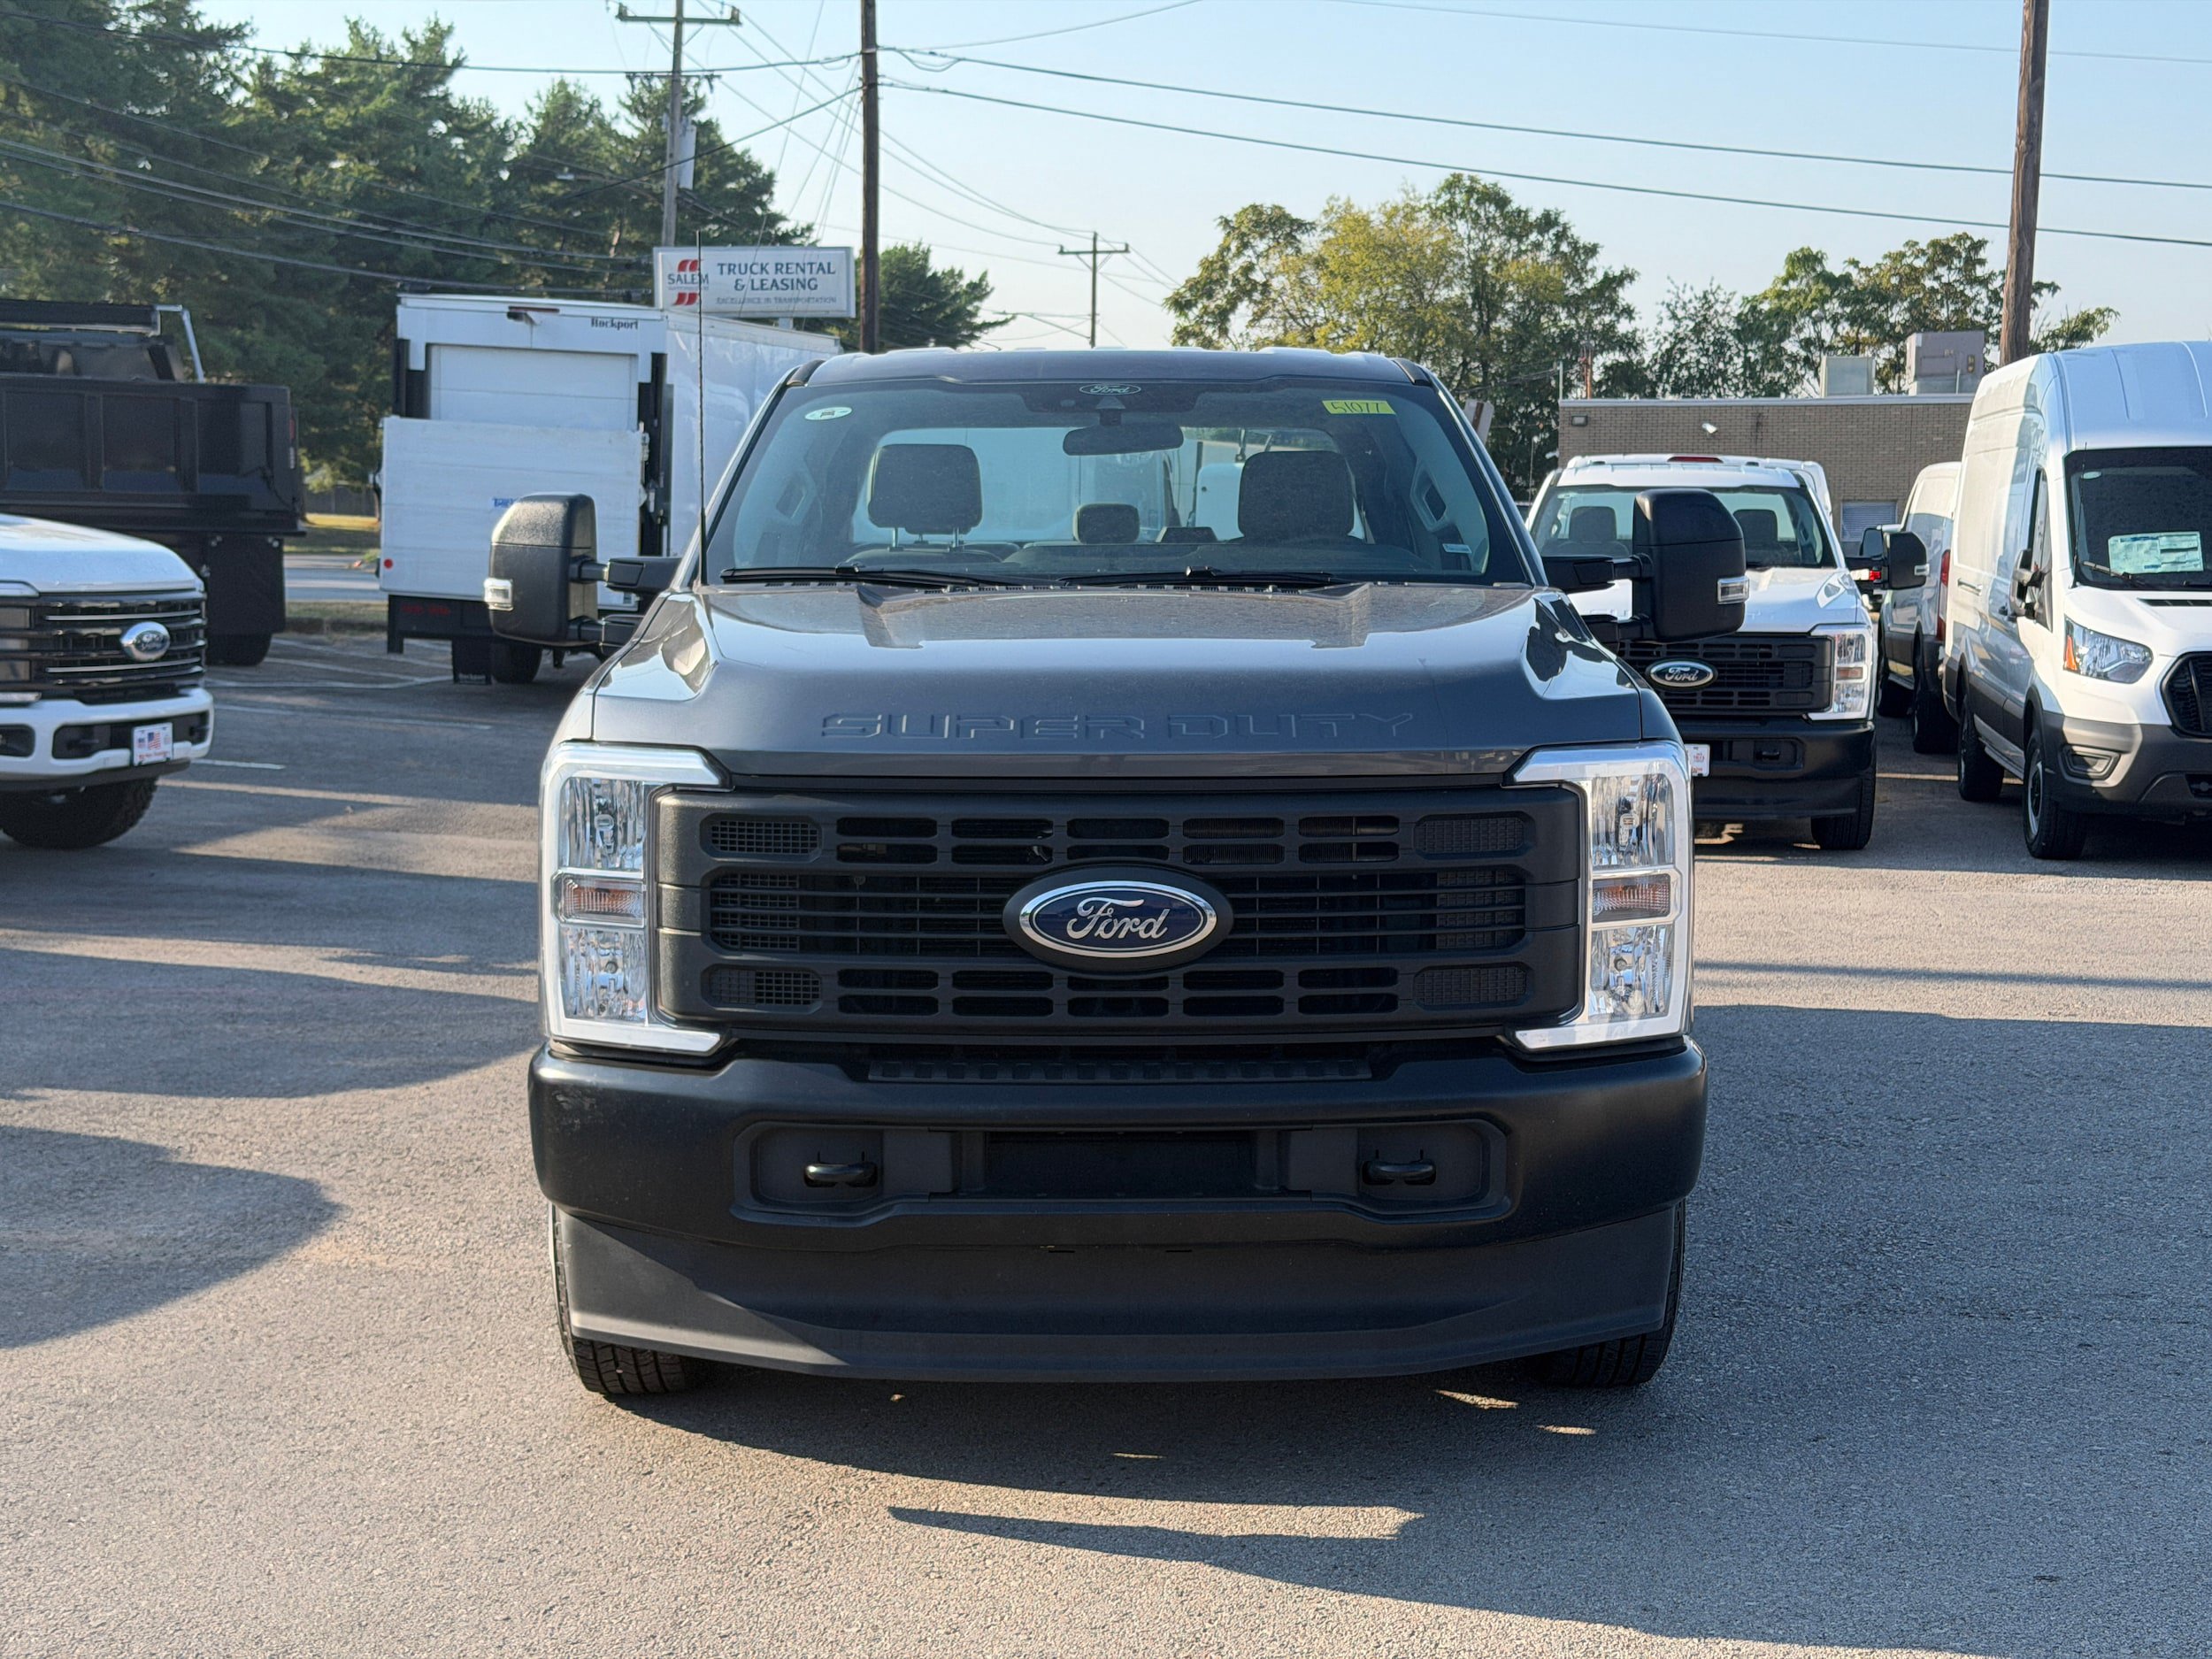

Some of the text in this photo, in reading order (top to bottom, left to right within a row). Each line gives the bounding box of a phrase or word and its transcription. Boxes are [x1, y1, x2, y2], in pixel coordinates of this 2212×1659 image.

[718, 262, 836, 275] TRUCK RENTAL
[667, 273, 710, 285] SALEM
[733, 278, 818, 291] & LEASING
[591, 316, 639, 331] Rockport
[1089, 384, 1131, 394] Ford
[1664, 666, 1700, 681] Ford
[821, 712, 1414, 739] SUPER DUTY
[1066, 896, 1171, 940] Ford
